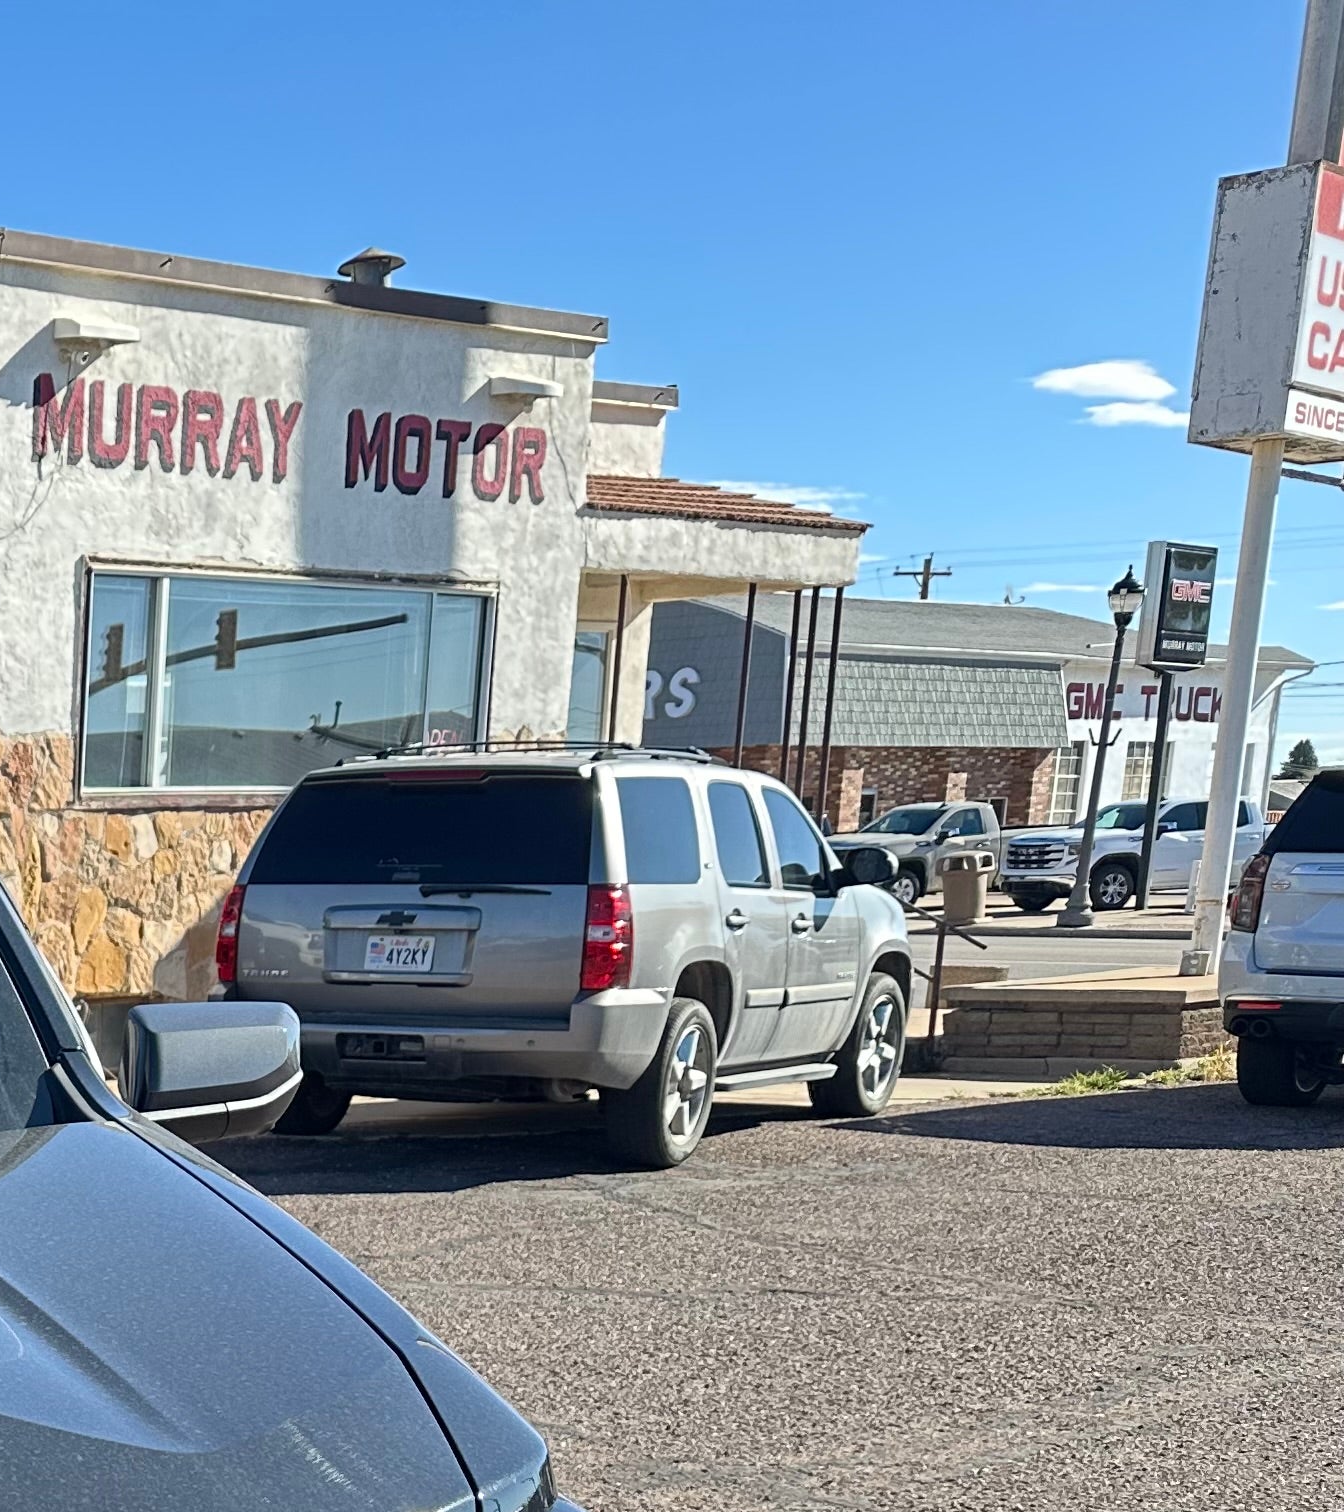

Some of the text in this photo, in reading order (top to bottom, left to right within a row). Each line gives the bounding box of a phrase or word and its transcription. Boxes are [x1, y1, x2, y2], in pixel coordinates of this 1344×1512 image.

[1317, 255, 1344, 311] U
[1294, 402, 1344, 433] SINCE
[31, 373, 548, 505] MURRAY MOTOR
[1171, 578, 1212, 604] GMC
[1141, 685, 1223, 722] TUCK
[386, 947, 430, 965] 4Y2KY
